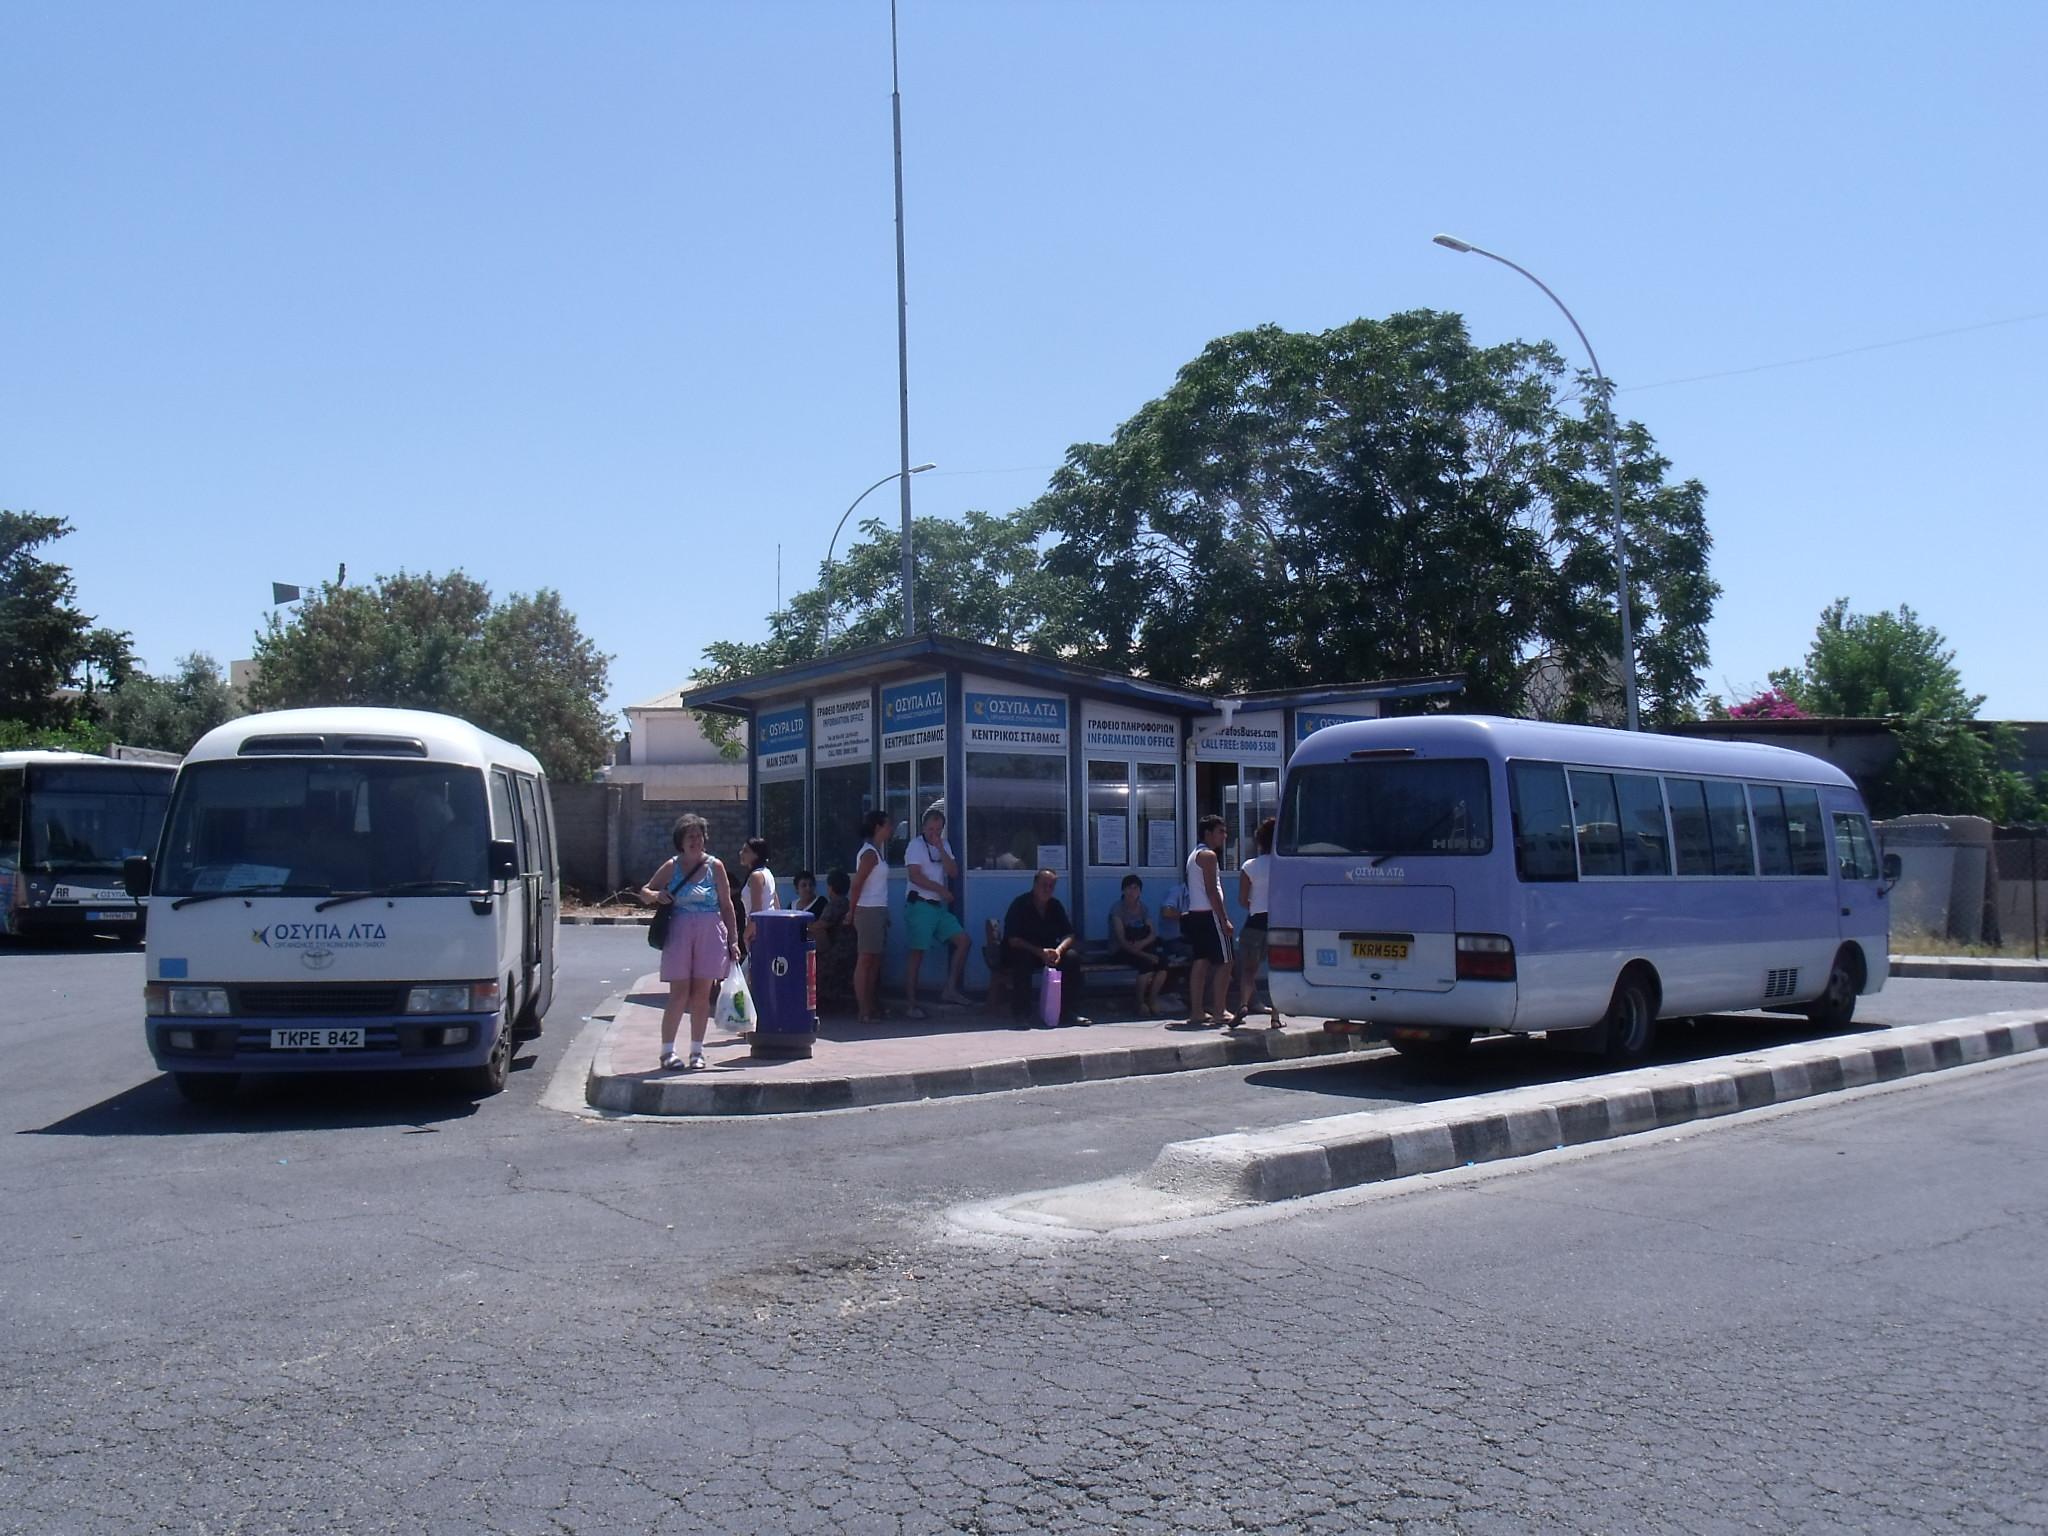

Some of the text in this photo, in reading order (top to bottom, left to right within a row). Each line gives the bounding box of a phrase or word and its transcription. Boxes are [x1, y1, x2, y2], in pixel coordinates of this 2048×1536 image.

[895, 690, 943, 713] ΟΣΥΠΑ ΛΤΔ
[989, 699, 1058, 717] ΟΣΥΠΑ ΛΤΔ
[769, 718, 804, 737] OSYPA LTD
[1088, 719, 1174, 734] ΓΡΑΦΕΙΟ ΠΛΗΡΟΦΟΡΙΩΝ
[884, 733, 916, 749] ΚΕΝΤΡΙΚΟΣ
[916, 729, 945, 745] ΣΤΑΘΜΟΣ
[971, 729, 1061, 744] ΚΕΝΤΡΙΚΟΣ ΣΤΑΘΜΟΣ
[1087, 733, 1175, 748] INFORMATION OFFICE
[1201, 739, 1218, 749] CALL
[1219, 740, 1239, 750] FREE:
[1432, 838, 1486, 849] HINO
[1354, 867, 1405, 877] ΟΣΥΠΑ ΛΤΔ
[274, 923, 387, 940] ΟΣΥΠΑ ΛΤΔ
[277, 1031, 359, 1046] TKPE 842
